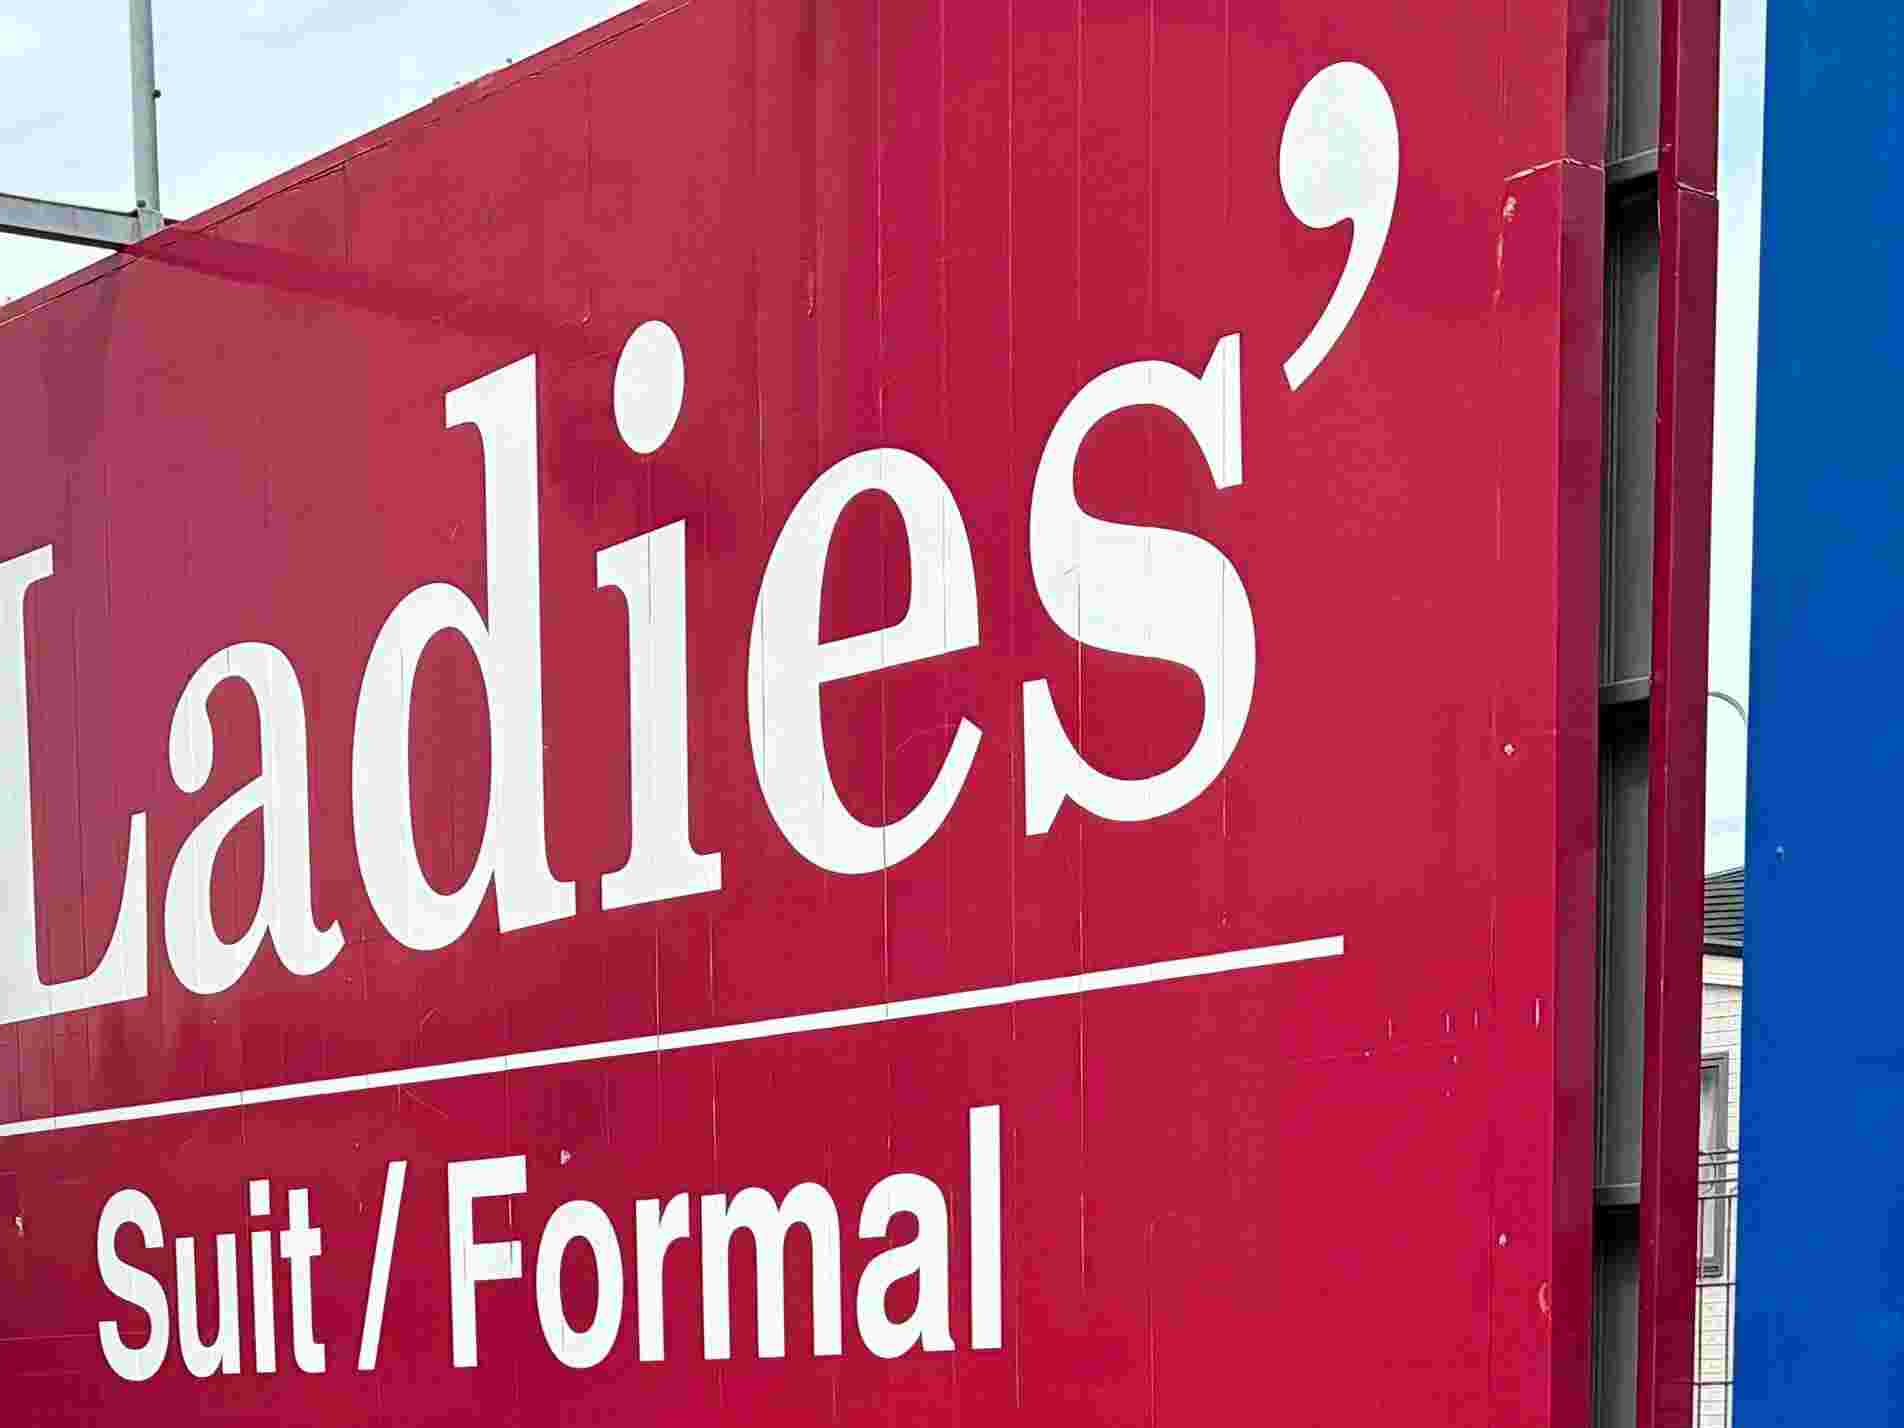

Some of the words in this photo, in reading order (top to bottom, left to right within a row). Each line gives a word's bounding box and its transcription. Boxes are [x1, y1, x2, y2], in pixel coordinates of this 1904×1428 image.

[98, 1174, 324, 1382] Suit
[358, 1161, 407, 1371] /
[450, 1106, 1003, 1370] Formal
